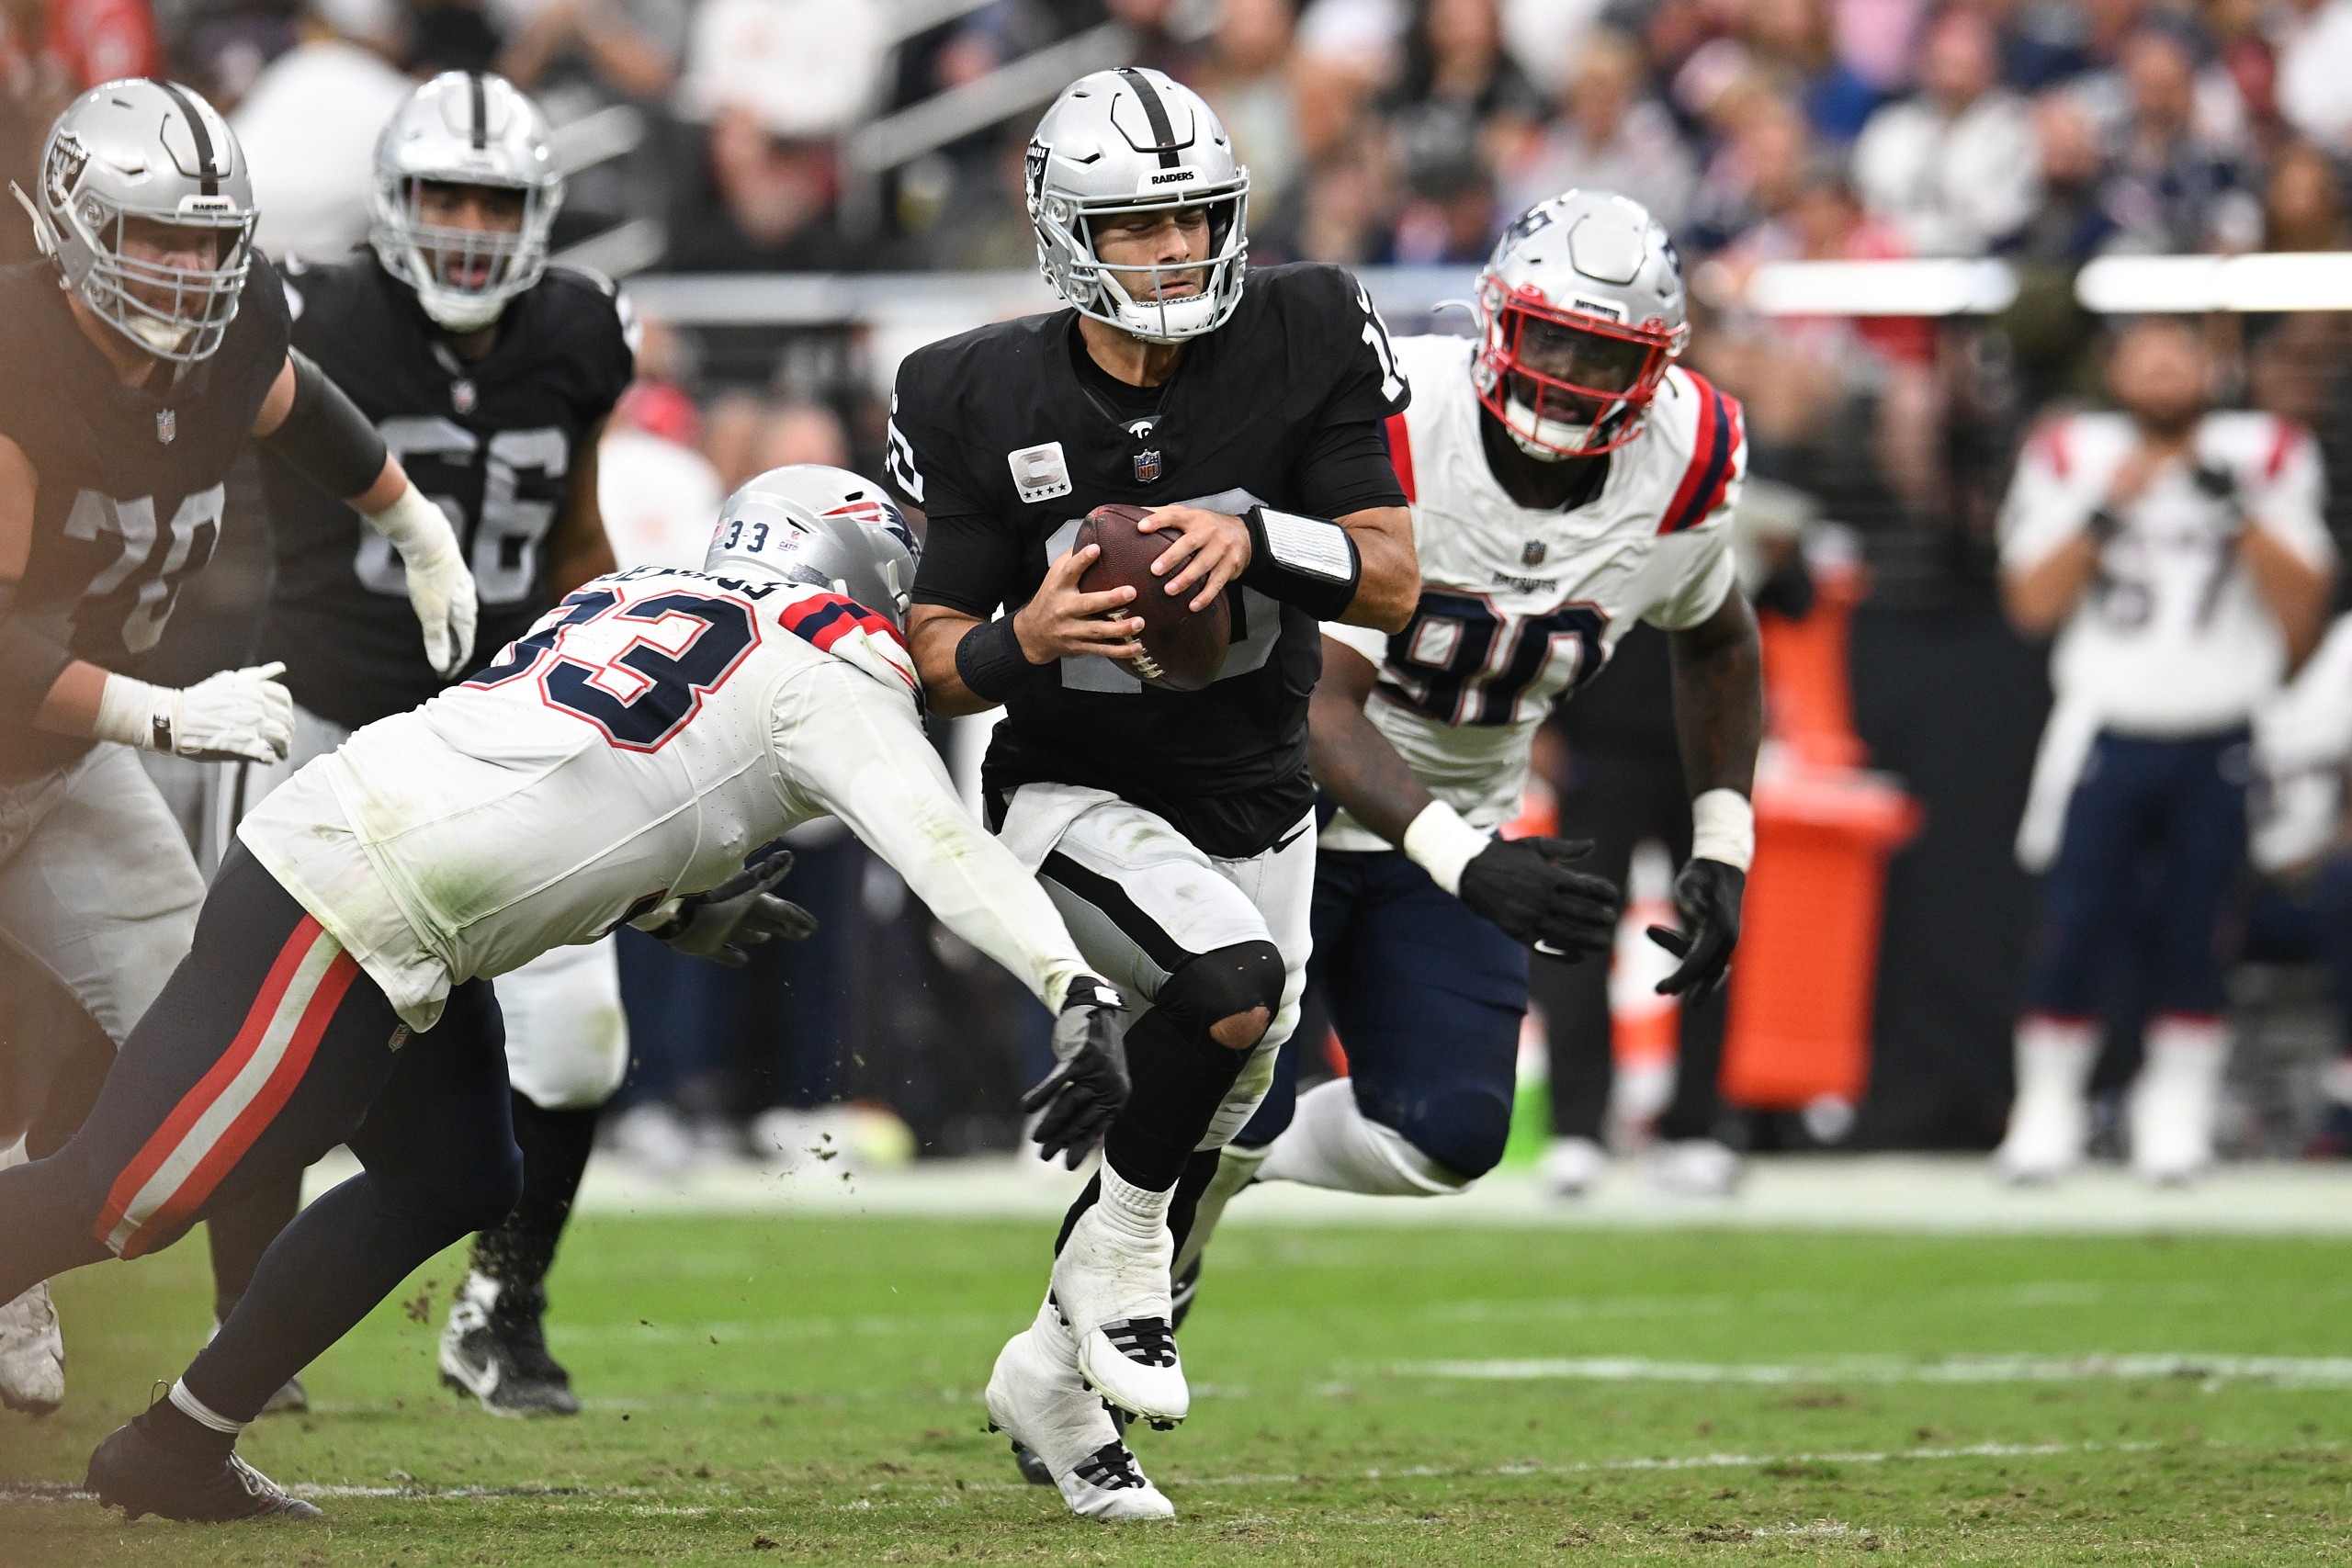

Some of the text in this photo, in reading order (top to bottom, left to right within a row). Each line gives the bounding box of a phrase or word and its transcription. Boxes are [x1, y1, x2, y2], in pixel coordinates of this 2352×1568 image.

[1151, 171, 1194, 185] RAIDERS
[57, 479, 226, 656] 70
[354, 415, 570, 604] 66
[458, 587, 762, 753] 33
[1365, 582, 1612, 728] 90
